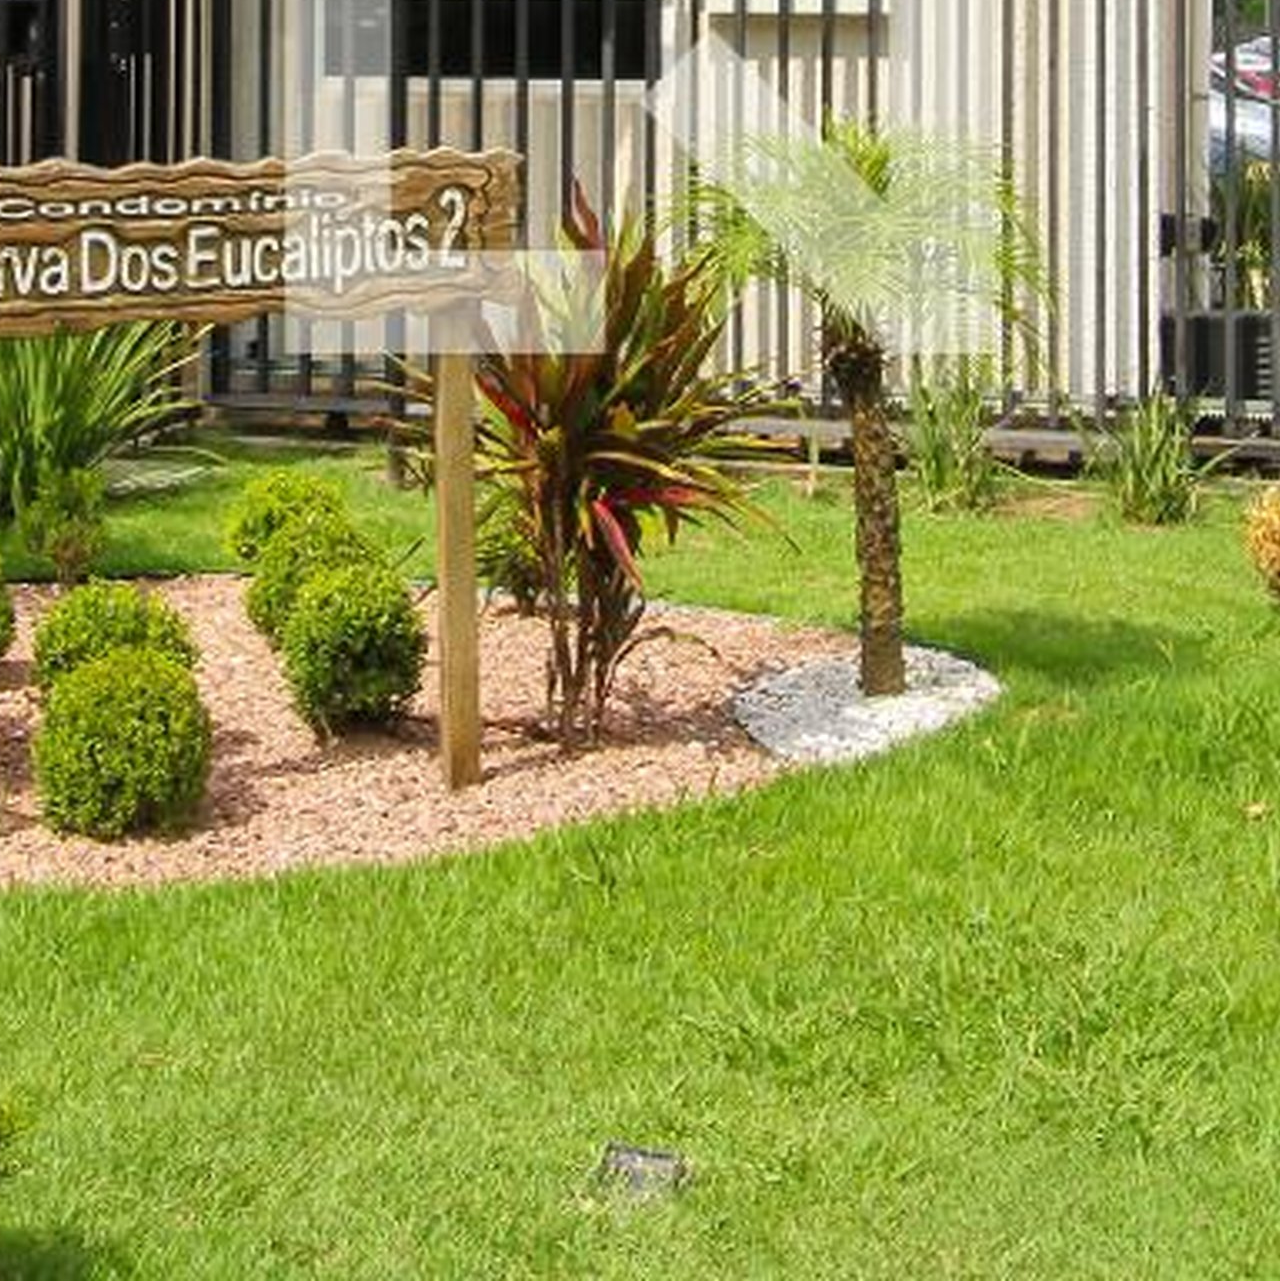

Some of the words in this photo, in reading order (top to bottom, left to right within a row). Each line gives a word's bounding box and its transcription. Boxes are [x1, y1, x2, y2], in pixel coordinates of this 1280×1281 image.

[79, 228, 179, 293] Dos
[184, 212, 429, 295] Eucaliptos
[437, 186, 467, 268] 2
